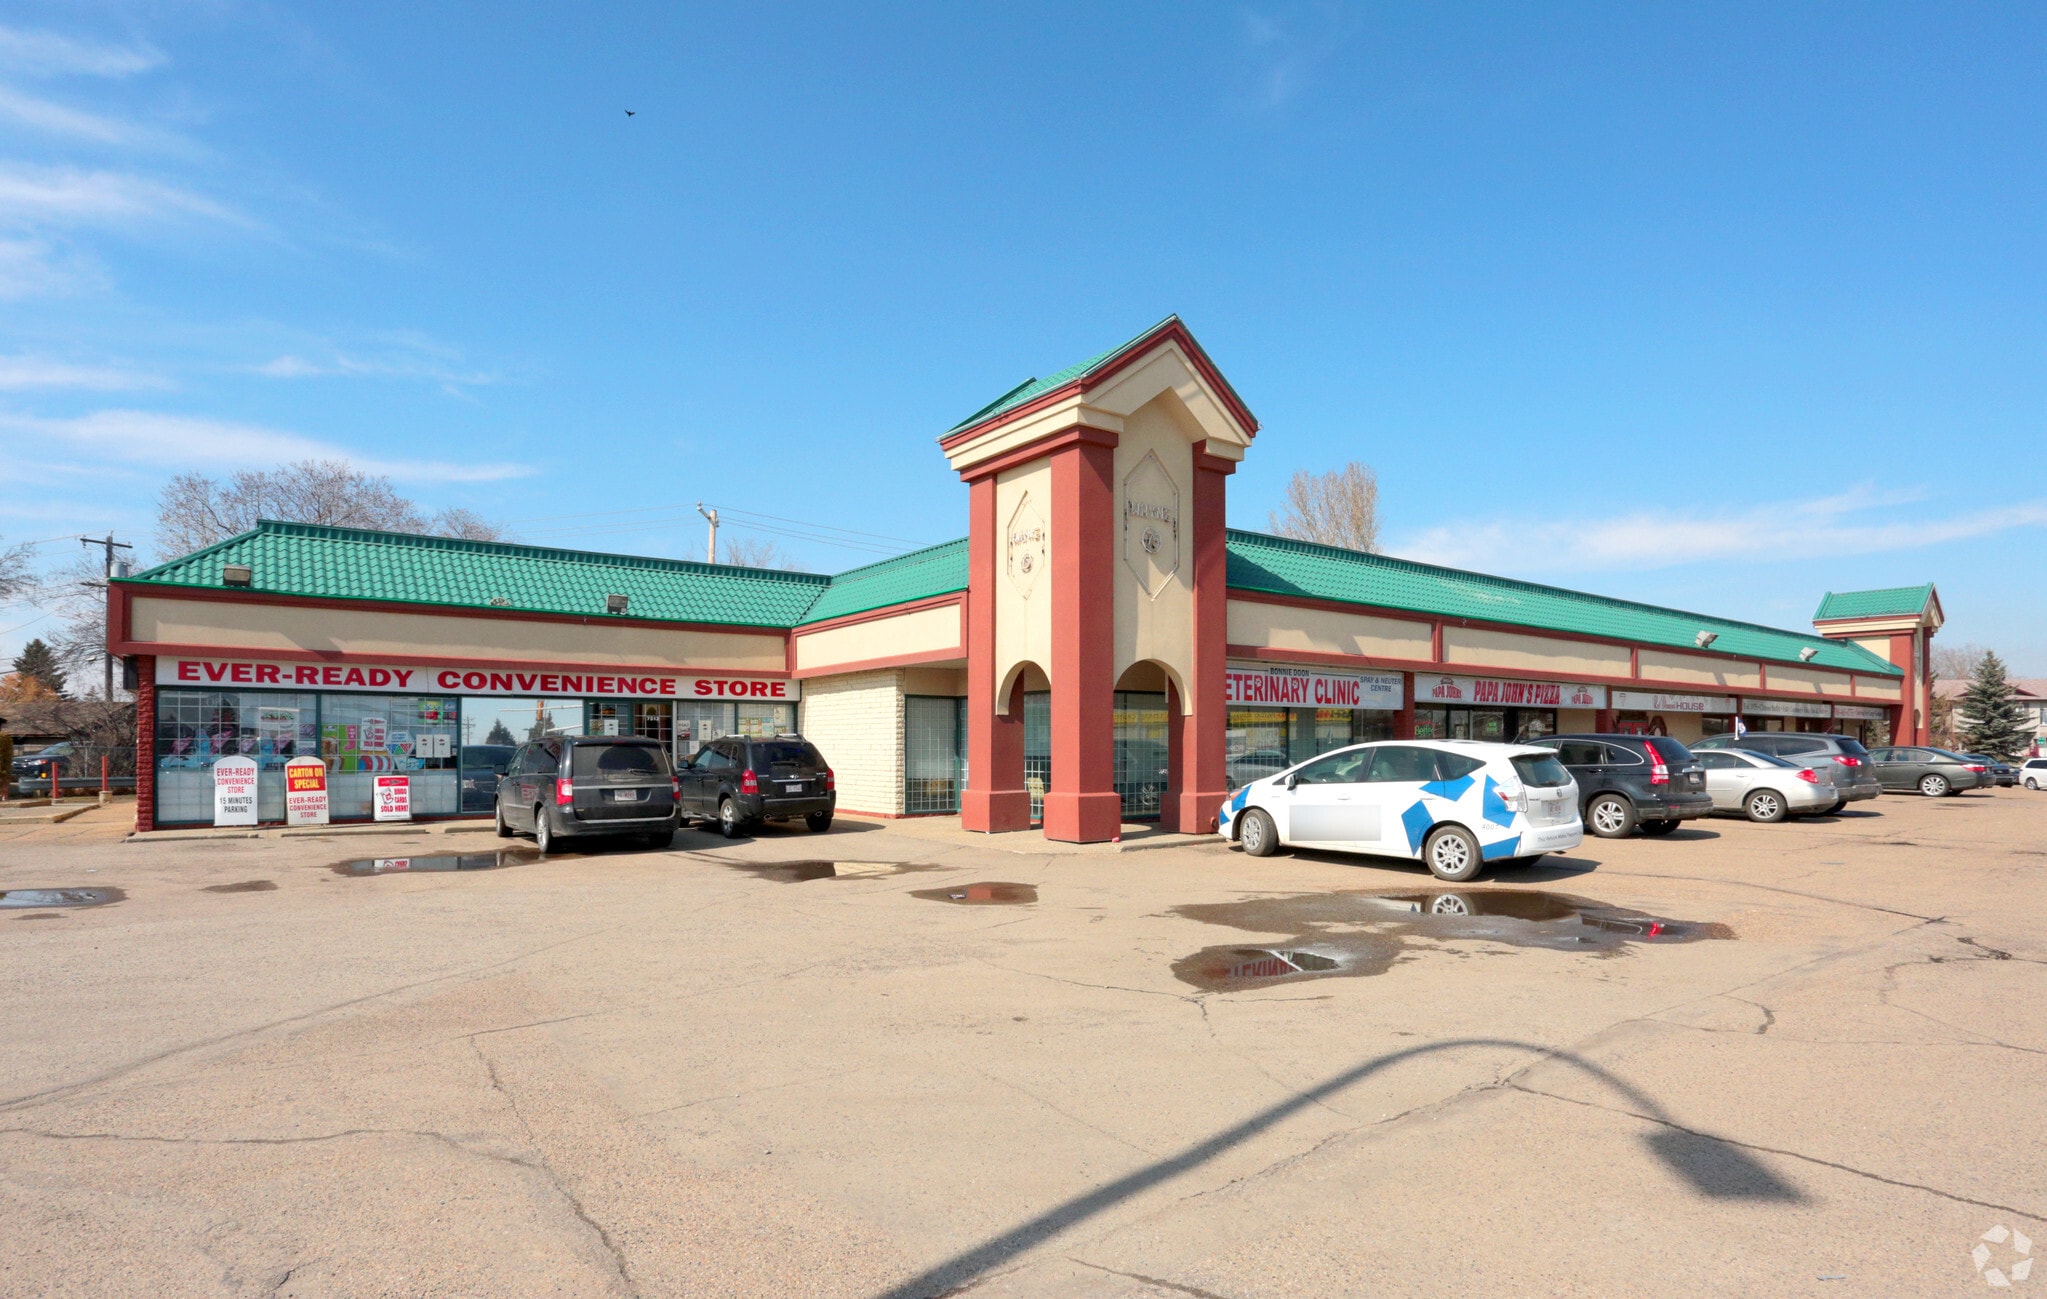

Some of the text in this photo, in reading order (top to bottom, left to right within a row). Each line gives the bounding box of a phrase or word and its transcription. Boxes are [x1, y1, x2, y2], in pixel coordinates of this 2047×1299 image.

[1270, 668, 1310, 677] BONNIE DOON
[178, 661, 786, 697] EVER-READY CONVENIENCE STORE
[1360, 676, 1374, 684] SPAY
[1381, 677, 1402, 685] NEUTER
[1226, 673, 1360, 705] ETERINARY CLINIC
[1370, 684, 1392, 692] CENTRE
[1473, 680, 1561, 704] PAPA JOHN'S PIZZA
[216, 767, 255, 776] EVER-READY
[289, 767, 323, 778] CARTON ON
[217, 777, 254, 785] CONVENIENCE
[294, 779, 319, 789] SPECIAL
[289, 796, 326, 804] EVER-READY
